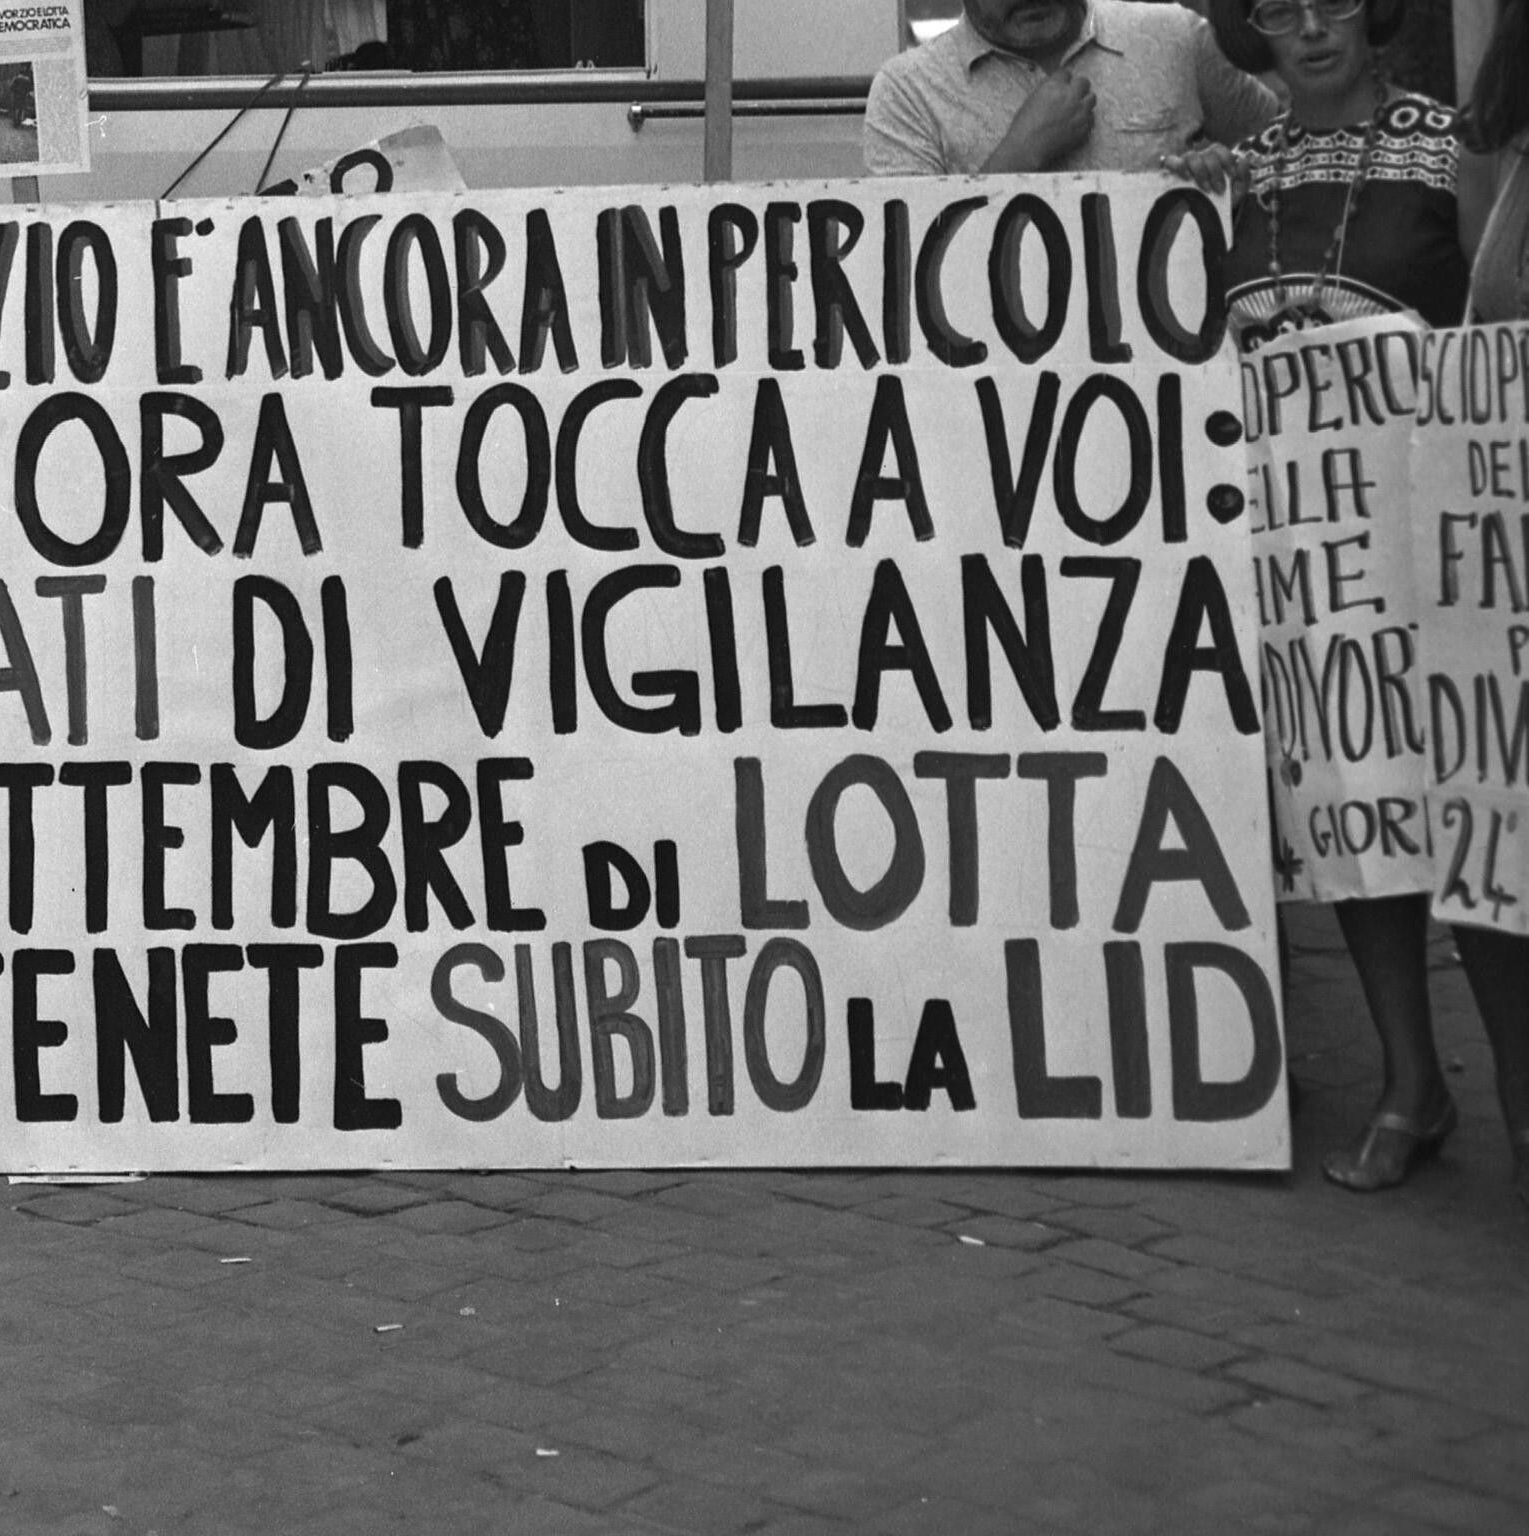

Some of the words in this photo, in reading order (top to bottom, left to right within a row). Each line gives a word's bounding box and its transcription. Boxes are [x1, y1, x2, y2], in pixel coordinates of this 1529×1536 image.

[43, 6, 70, 17] LOTTA
[224, 207, 579, 382] ANCORA
[595, 204, 690, 372] IN
[707, 187, 1230, 371] PERICOLO
[14, 389, 323, 567] ORA
[369, 373, 816, 559] TOCCA
[844, 374, 937, 550] A
[974, 370, 1246, 550] VOI:
[232, 573, 354, 750] DI
[432, 551, 1261, 739] VIGILANZA
[1263, 621, 1426, 763] DIVOR
[581, 838, 680, 930] DI
[732, 750, 1253, 933] LOTTA
[428, 933, 826, 1124] SUBITO
[845, 995, 977, 1112] LA
[1003, 936, 1284, 1124] LID
